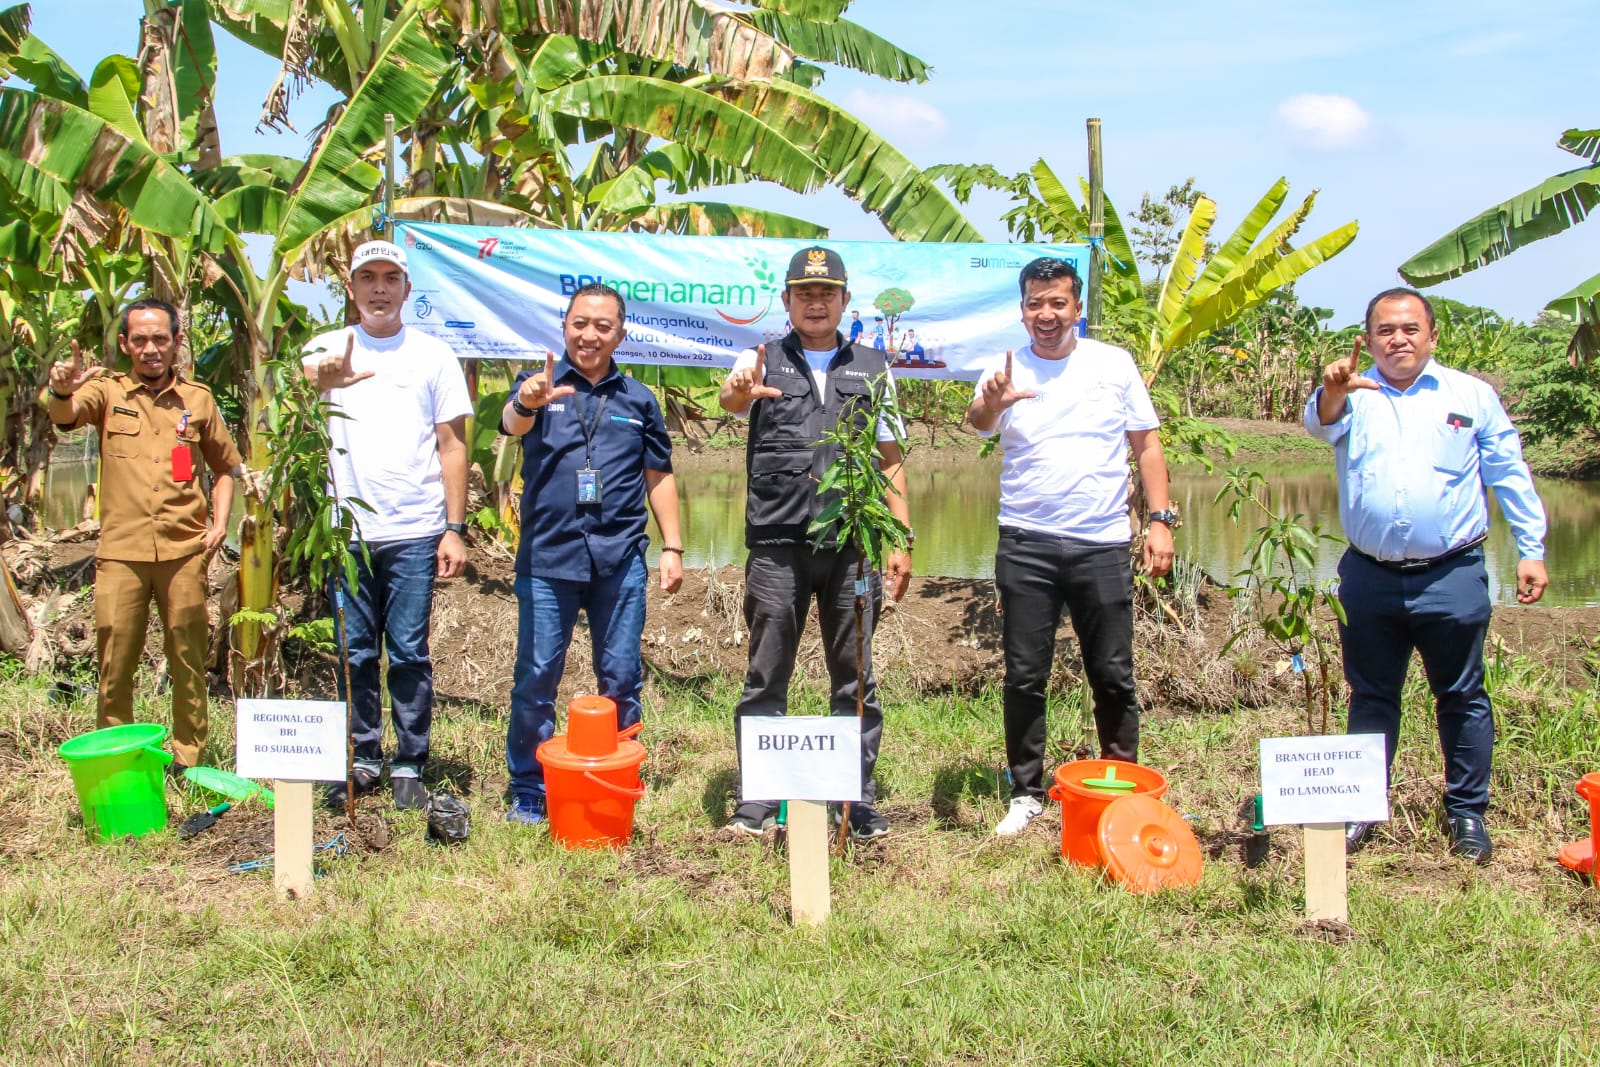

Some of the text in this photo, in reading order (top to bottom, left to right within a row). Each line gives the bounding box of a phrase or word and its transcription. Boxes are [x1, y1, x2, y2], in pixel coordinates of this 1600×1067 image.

[253, 713, 323, 723] REGIONAL CEO
[280, 728, 297, 737] BRI
[758, 734, 836, 751] BUPATI
[254, 744, 322, 754] RO SURABAYA
[1275, 750, 1362, 763] BRANCH OFFICE
[1303, 767, 1335, 777] HEAD
[1279, 784, 1361, 797] BO LAMONGAN
